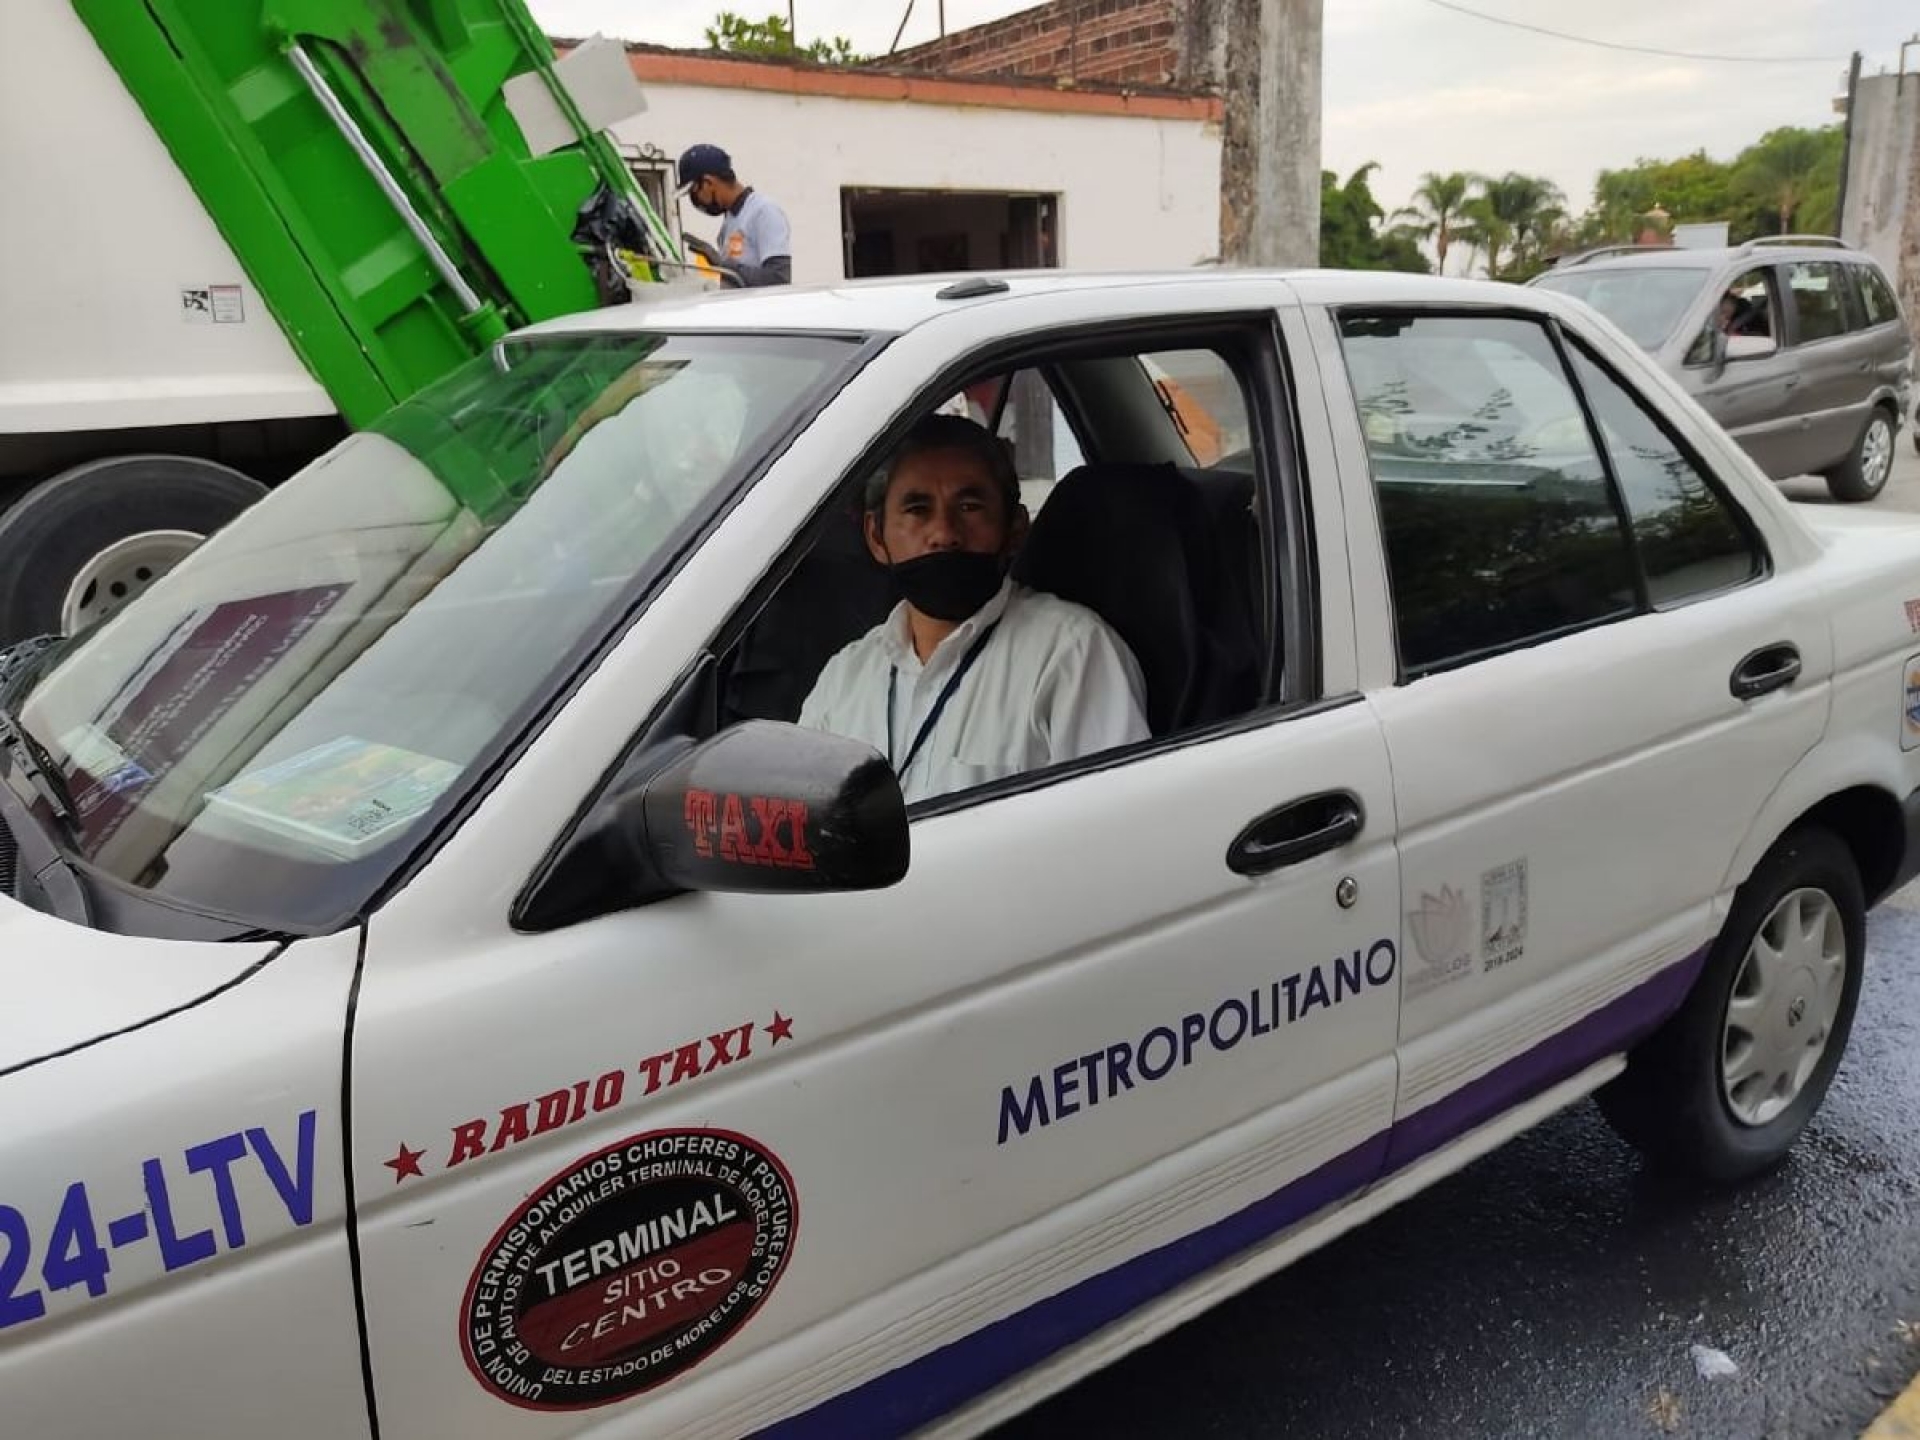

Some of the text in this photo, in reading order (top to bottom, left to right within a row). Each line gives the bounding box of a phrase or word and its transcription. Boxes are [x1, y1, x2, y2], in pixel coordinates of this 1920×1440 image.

[685, 788, 816, 869] TAXI
[446, 1022, 754, 1168] RADIO TAXI
[998, 939, 1396, 1145] METROPOLITANO
[0, 1109, 316, 1329] 24-LTV
[475, 1136, 788, 1400] UNION DE PERMISIONARIOS CHOFERES Y POSTUREROS
[499, 1159, 769, 1365] DE AUTOS DE ALQUILER TERMINAL DE MORELOS
[535, 1193, 738, 1296] TERMINAL
[603, 1258, 680, 1305] SITIO
[542, 1281, 748, 1385] DEL ESTADO DE MORELOS
[560, 1268, 732, 1351] CENTRO
